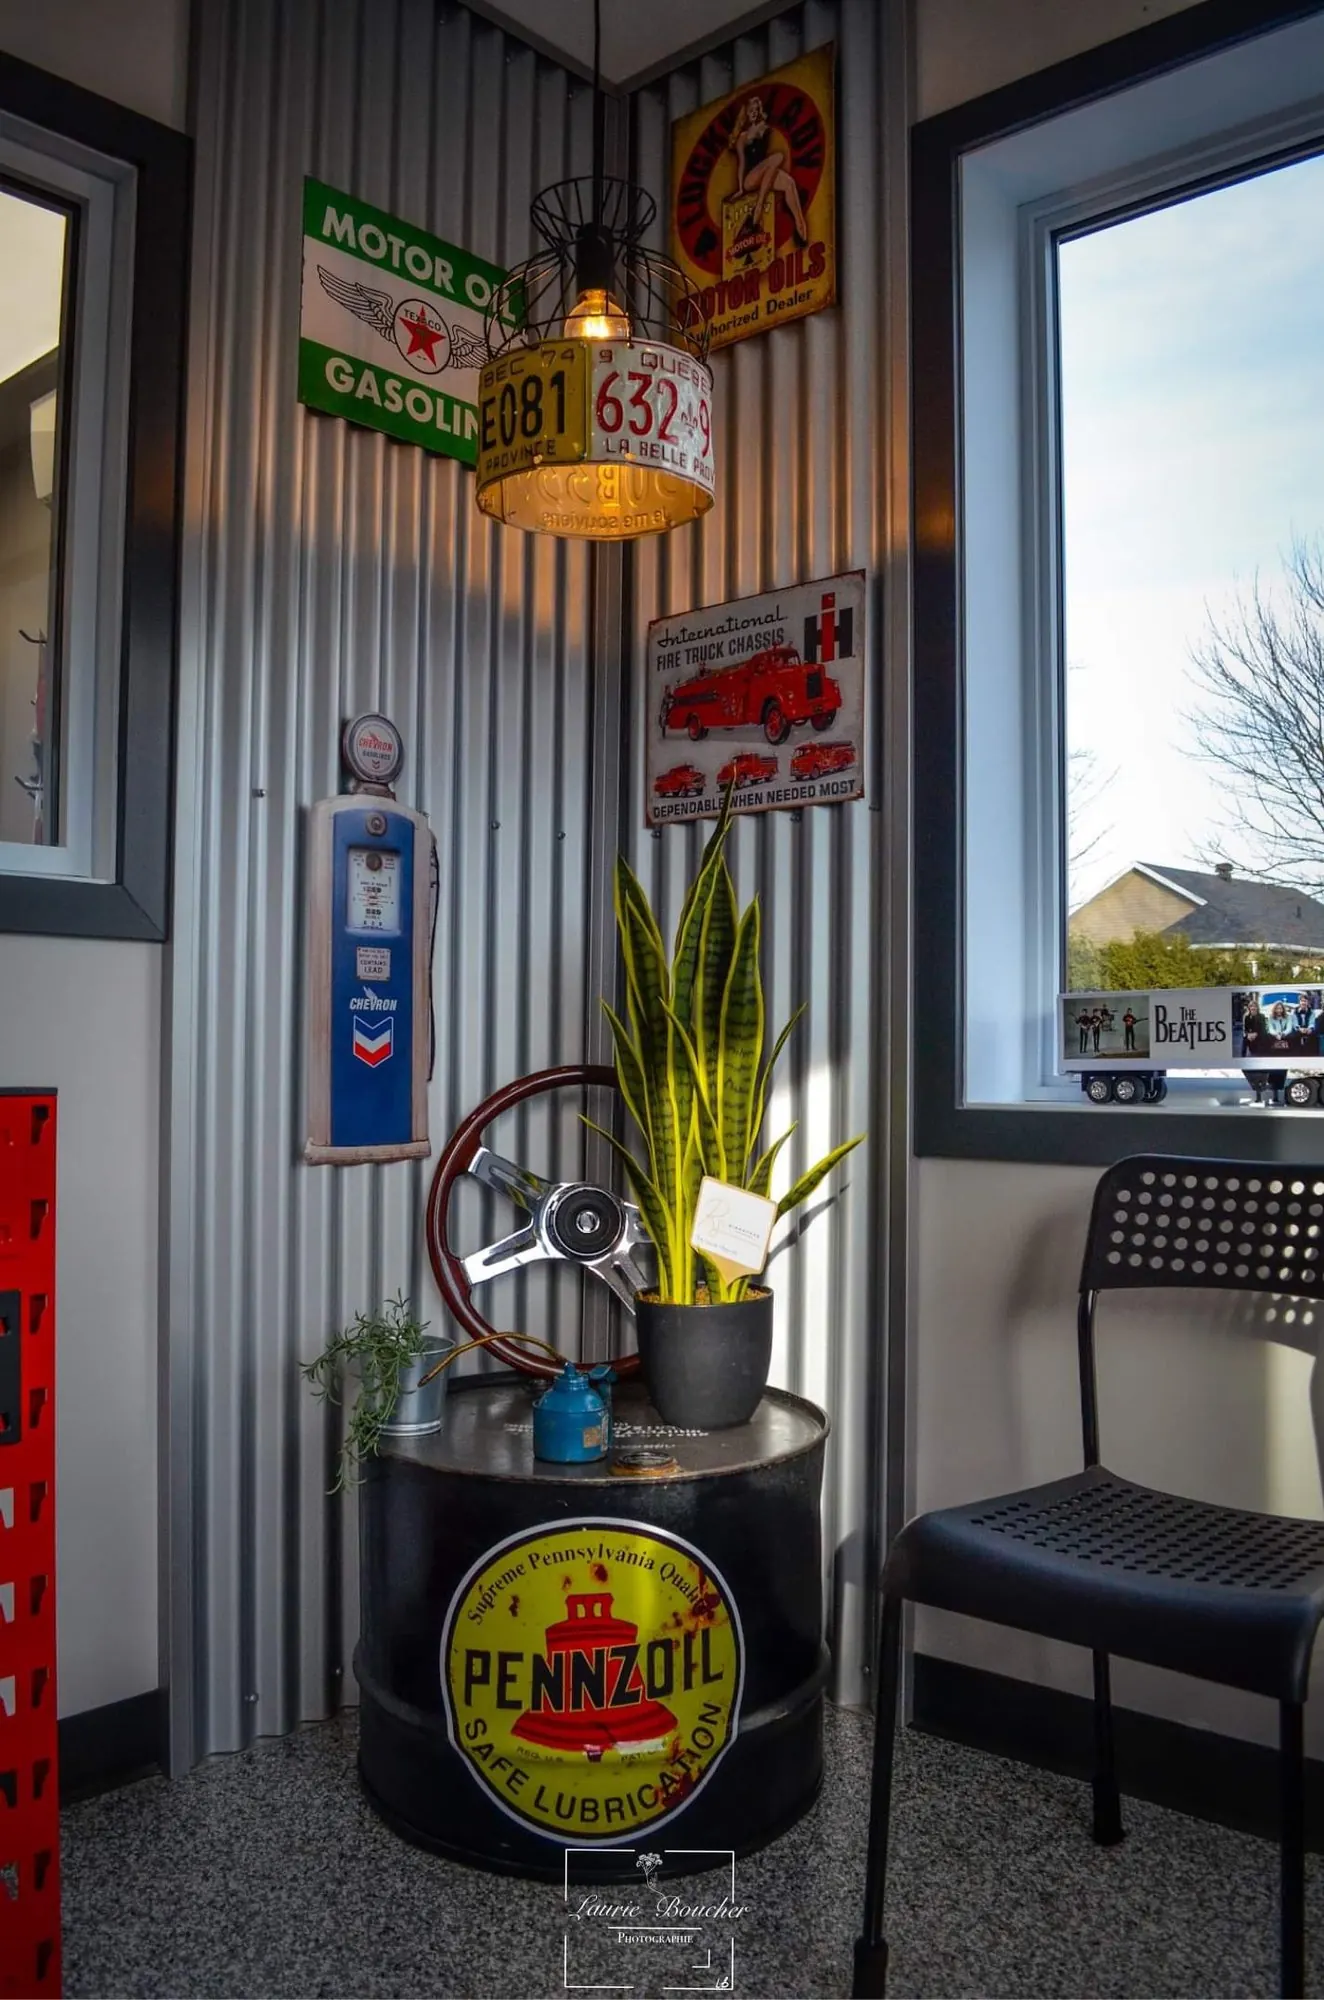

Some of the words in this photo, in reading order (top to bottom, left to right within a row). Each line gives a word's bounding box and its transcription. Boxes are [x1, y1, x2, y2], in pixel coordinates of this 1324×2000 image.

[322, 206, 455, 294] MOTOR
[465, 274, 517, 323] OIL
[677, 268, 760, 326] MOTOR
[768, 241, 826, 294] OILS
[404, 308, 442, 332] TEXACO
[689, 305, 759, 345] Auhorized
[766, 288, 814, 315] Dealer
[541, 348, 575, 368] 74
[641, 351, 712, 396] QUÉBE
[325, 356, 478, 441] GASOLIN
[482, 370, 565, 452] E081
[486, 440, 556, 472] PROVINCE
[606, 438, 630, 454] LA
[640, 440, 688, 469] BELLE
[657, 604, 786, 648] International
[656, 651, 681, 672] FIRE
[685, 641, 724, 665] TRUCK
[728, 627, 785, 655] CHASSIS
[359, 736, 393, 753] CHEVRON
[653, 798, 724, 819] DEPENDABLE
[730, 791, 763, 808] WHEN
[766, 784, 816, 804] NEEDED
[820, 779, 856, 796] MOST
[349, 997, 398, 1011] CHEVRON
[1180, 1006, 1197, 1022] THE
[1154, 1004, 1227, 1050] BEATLES
[466, 1561, 527, 1626] Supreme
[527, 1543, 655, 1572] Pennsylvania
[659, 1561, 711, 1611] Quali
[463, 1627, 724, 1714] PENNZOIL
[465, 1717, 530, 1796] SAFE
[533, 1702, 723, 1824] LUBRICATION
